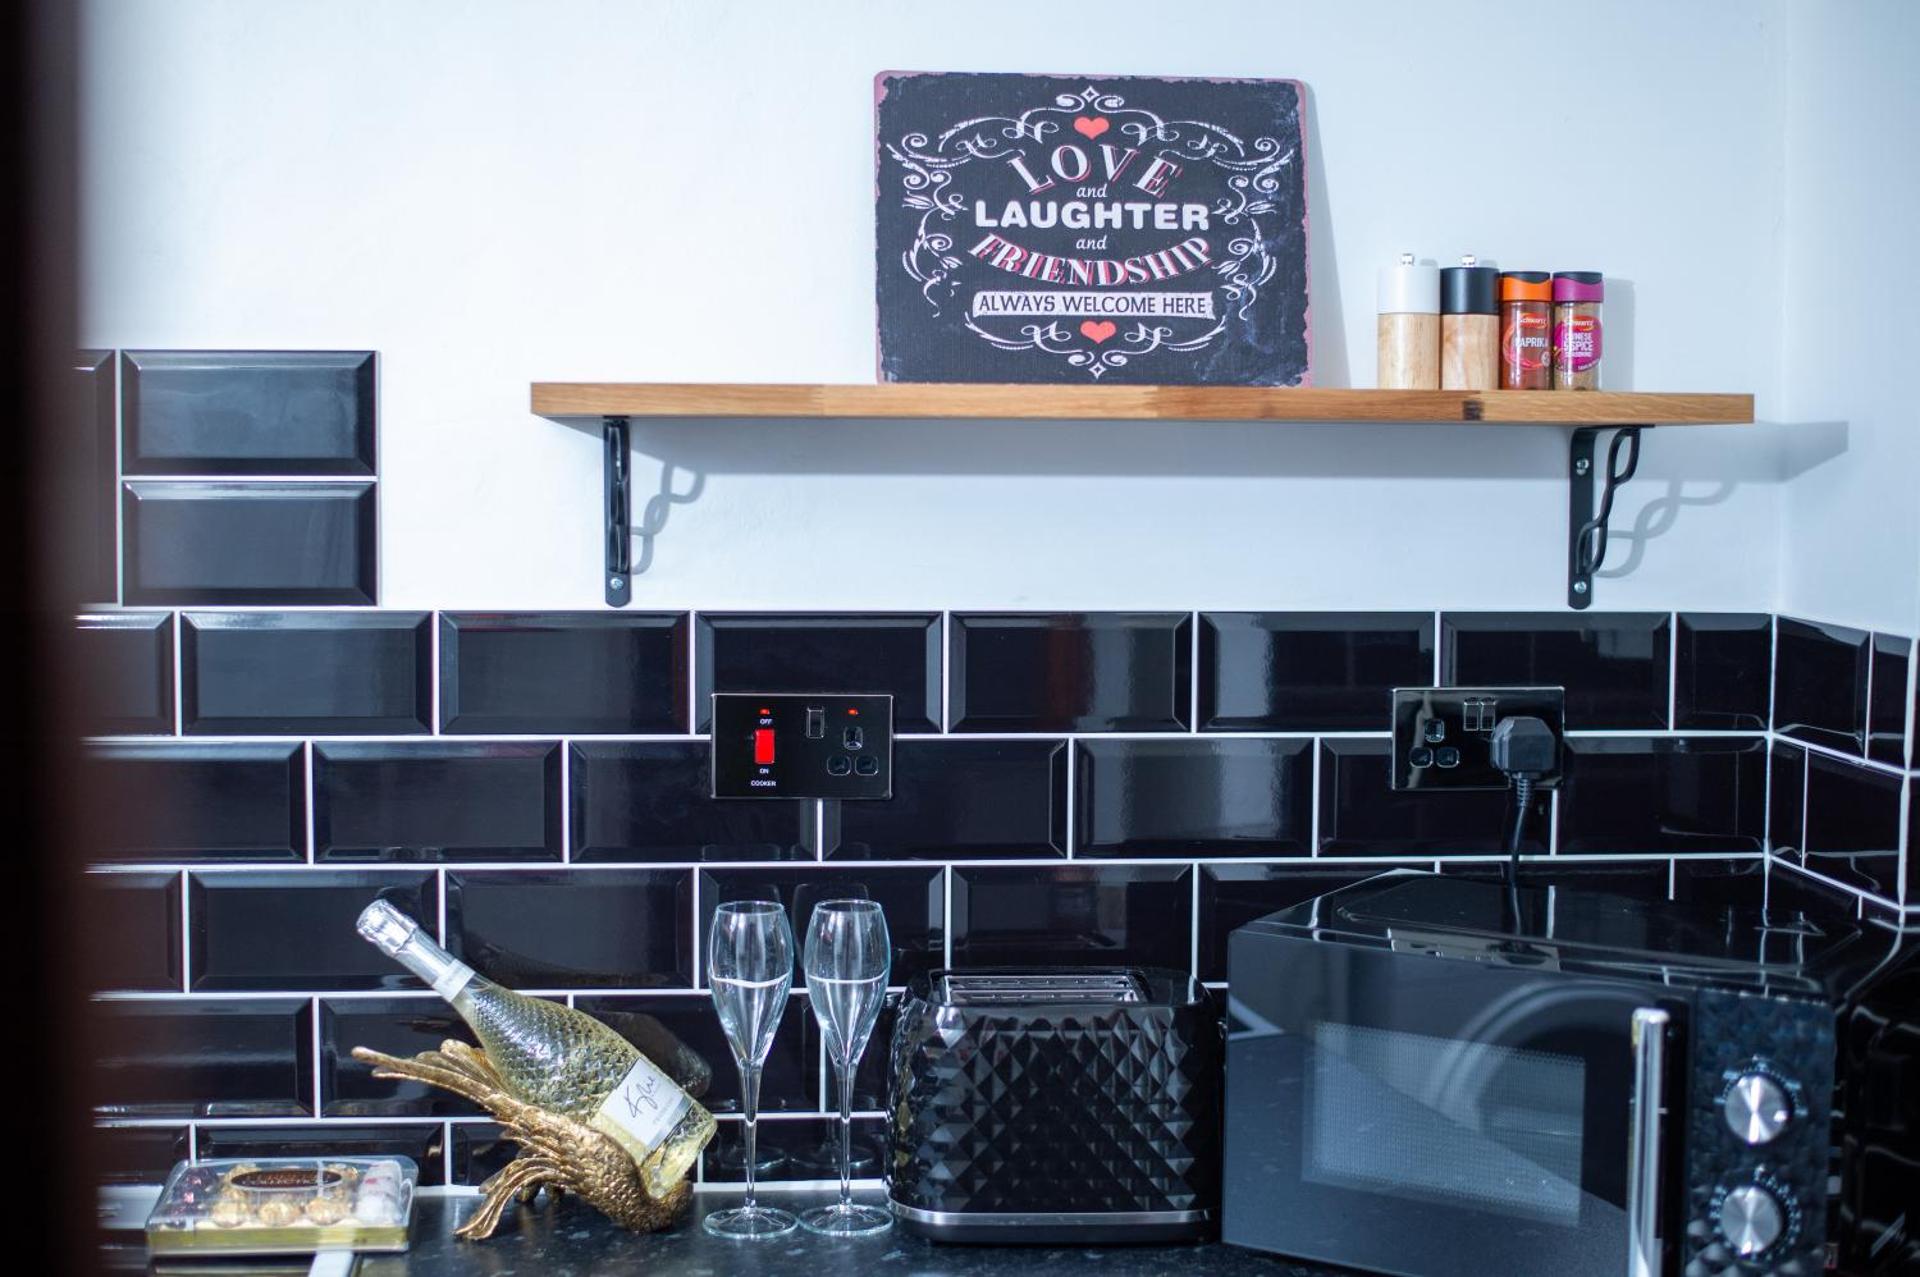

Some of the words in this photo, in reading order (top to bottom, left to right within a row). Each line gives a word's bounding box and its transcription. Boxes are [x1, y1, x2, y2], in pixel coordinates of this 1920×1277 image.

[1007, 143, 1183, 198] LOVE
[1076, 184, 1108, 198] and
[974, 200, 1209, 231] LAUGHTER
[1076, 235, 1107, 250] and
[967, 233, 1213, 286] FRIENDSHIP
[978, 295, 1055, 312] ALWAYS
[1062, 295, 1156, 313] WELCOME
[1163, 297, 1207, 314] HERE
[1564, 333, 1592, 342] CINESE
